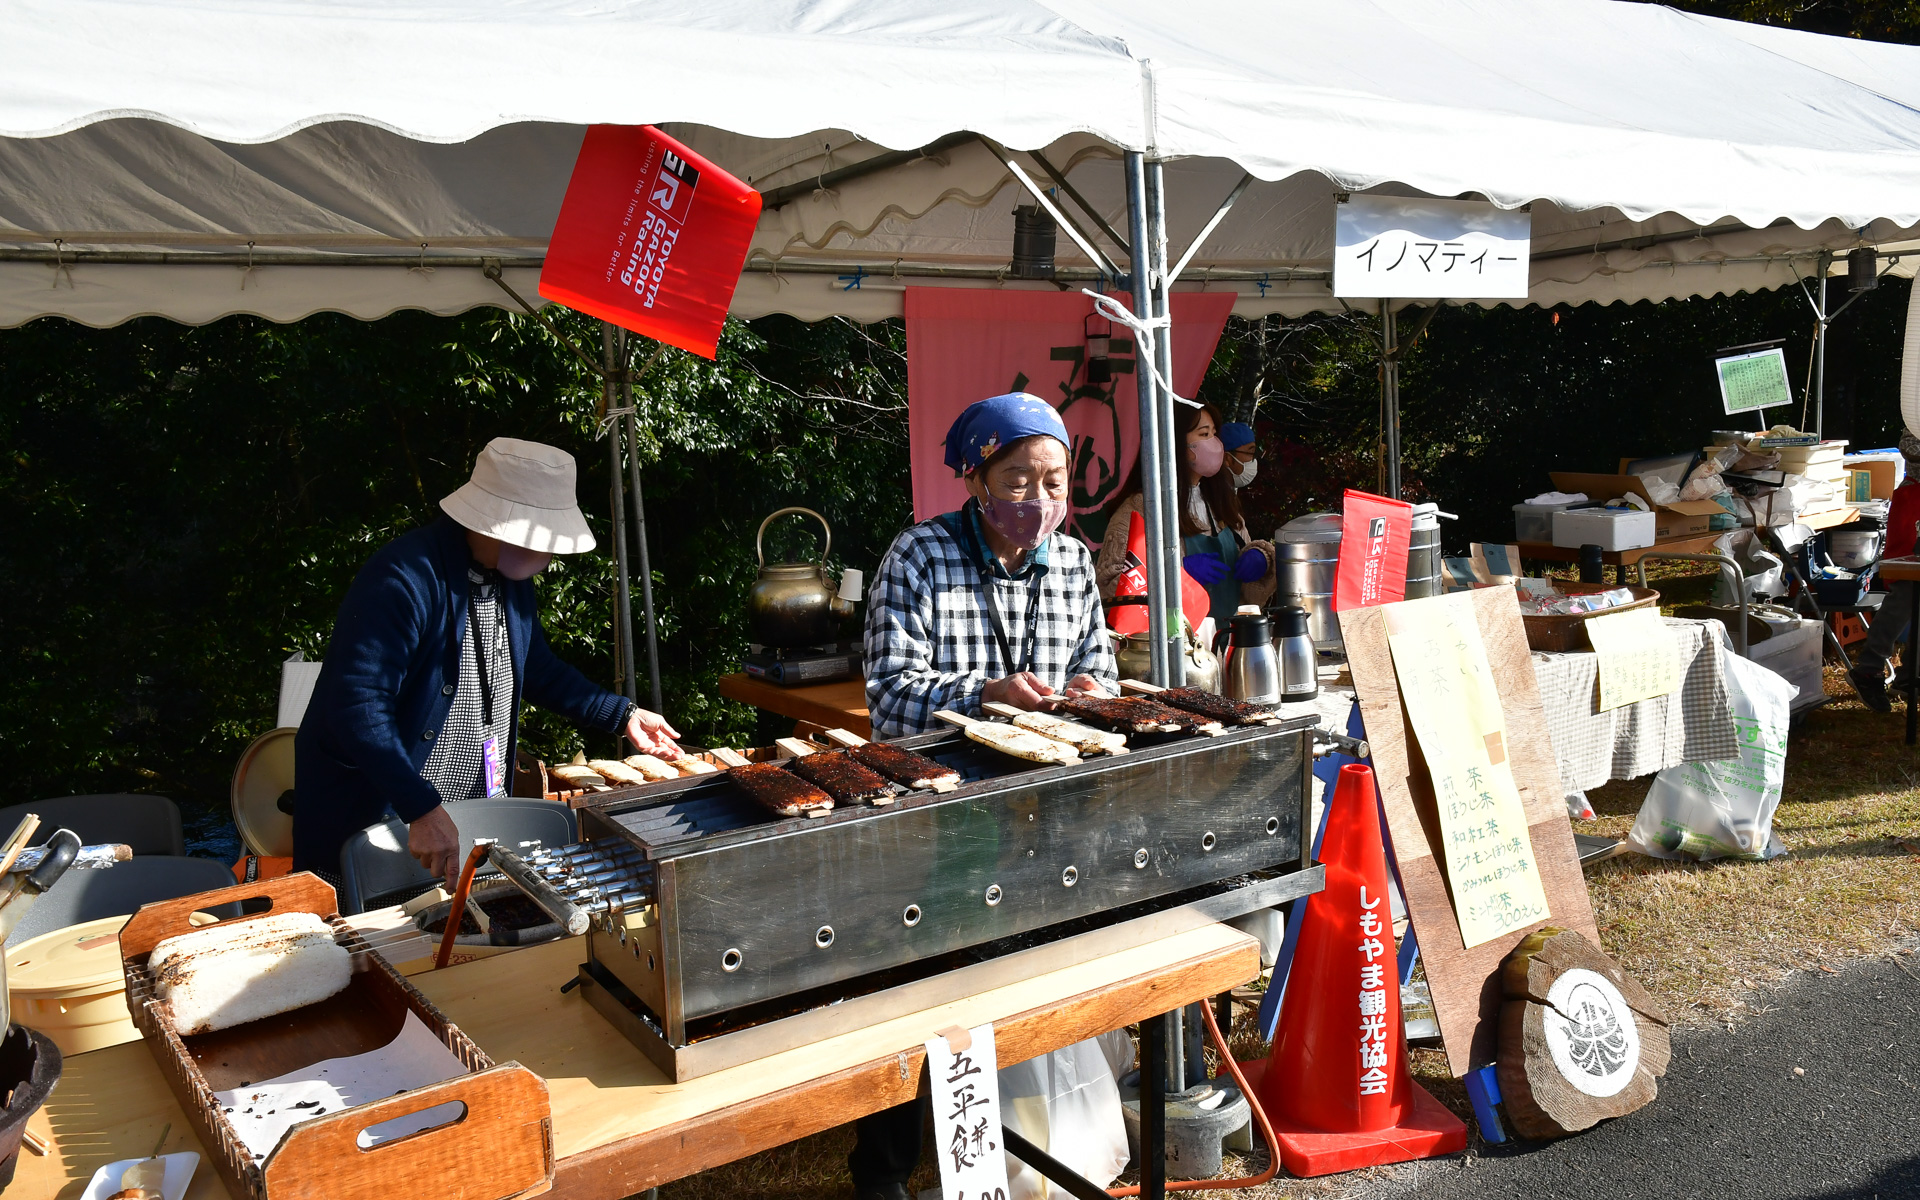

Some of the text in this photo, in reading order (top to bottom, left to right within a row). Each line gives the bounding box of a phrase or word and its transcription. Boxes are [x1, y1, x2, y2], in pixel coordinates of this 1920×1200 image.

[605, 139, 658, 284] ushing the limits for Better
[620, 209, 657, 287] Racing
[633, 217, 668, 296] GAZOO
[643, 228, 680, 309] TOYOTA
[1356, 238, 1518, 275] イノマティー
[1447, 790, 1495, 821] ほうじ茶
[1494, 903, 1543, 933] 300えん
[1357, 885, 1389, 1096] しもやま観光協会
